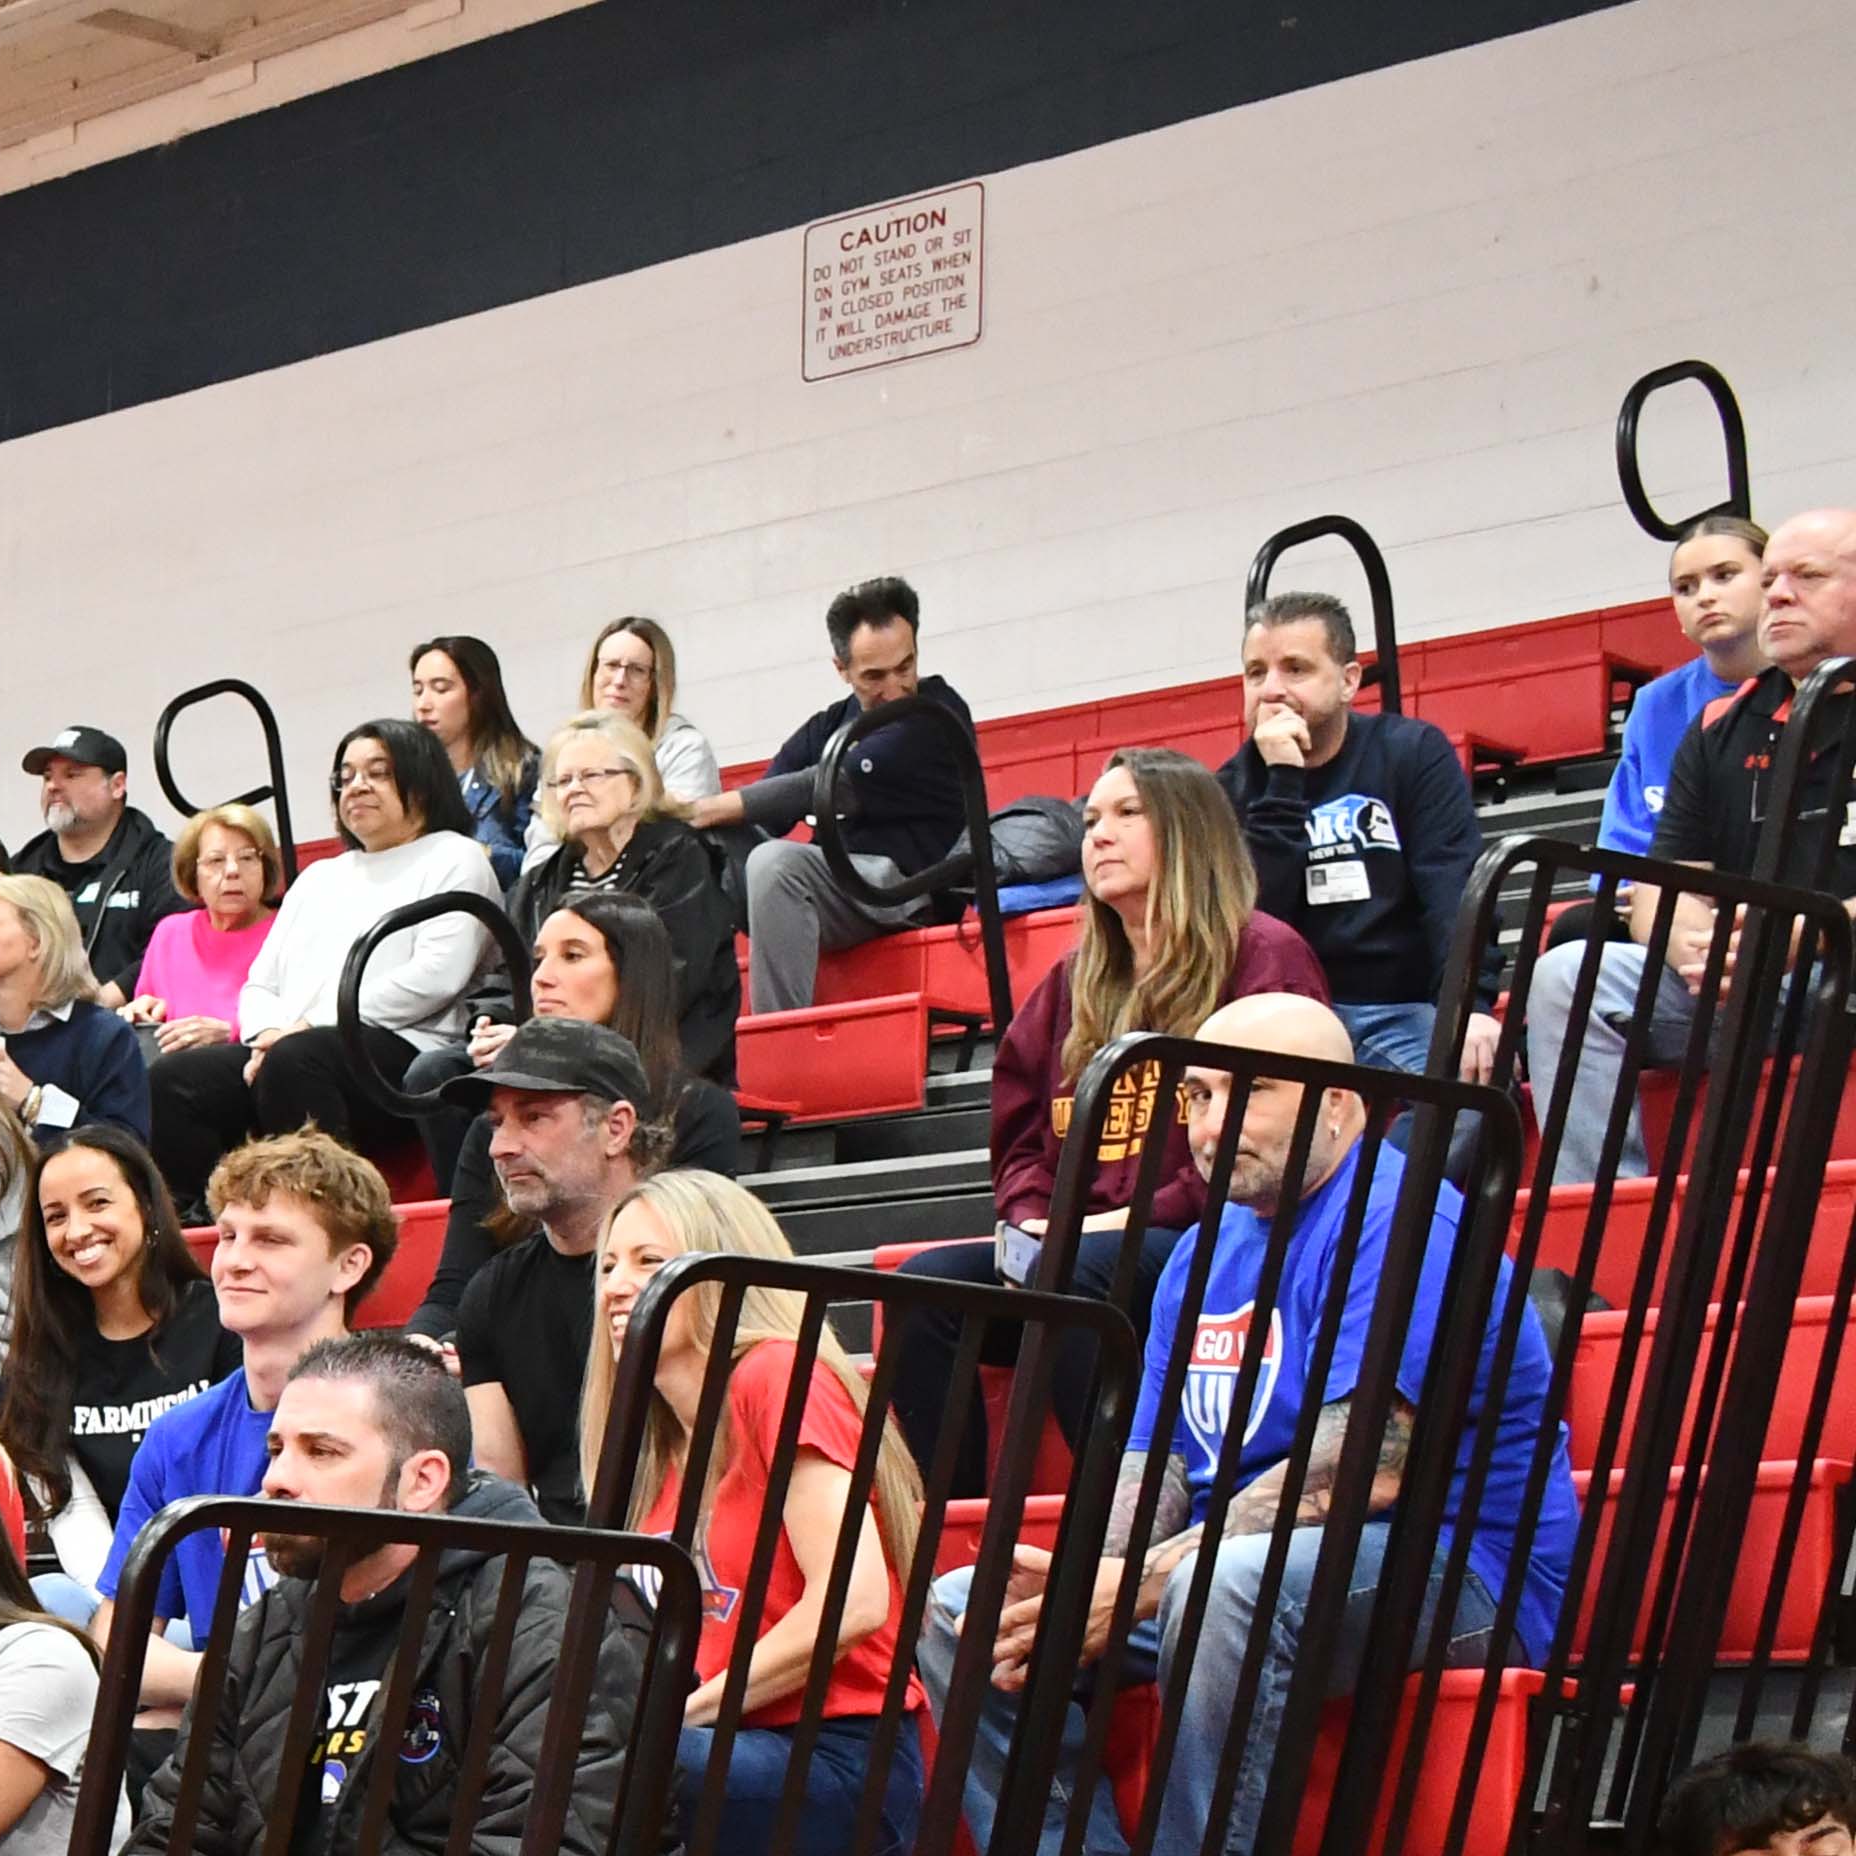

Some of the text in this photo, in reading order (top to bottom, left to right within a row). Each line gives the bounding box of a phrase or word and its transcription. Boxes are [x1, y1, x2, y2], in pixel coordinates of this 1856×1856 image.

[840, 207, 947, 252] CAUTION
[813, 229, 972, 283] DO NOT STAND OR SIT
[814, 251, 972, 303] ON GYM SEATS WHEN
[816, 293, 968, 343] IT WILL DAMAGE THE
[819, 273, 965, 322] IN CLOSED POSITION
[828, 317, 953, 361] UNDERSTRUCTURE
[1196, 1329, 1233, 1360] GO
